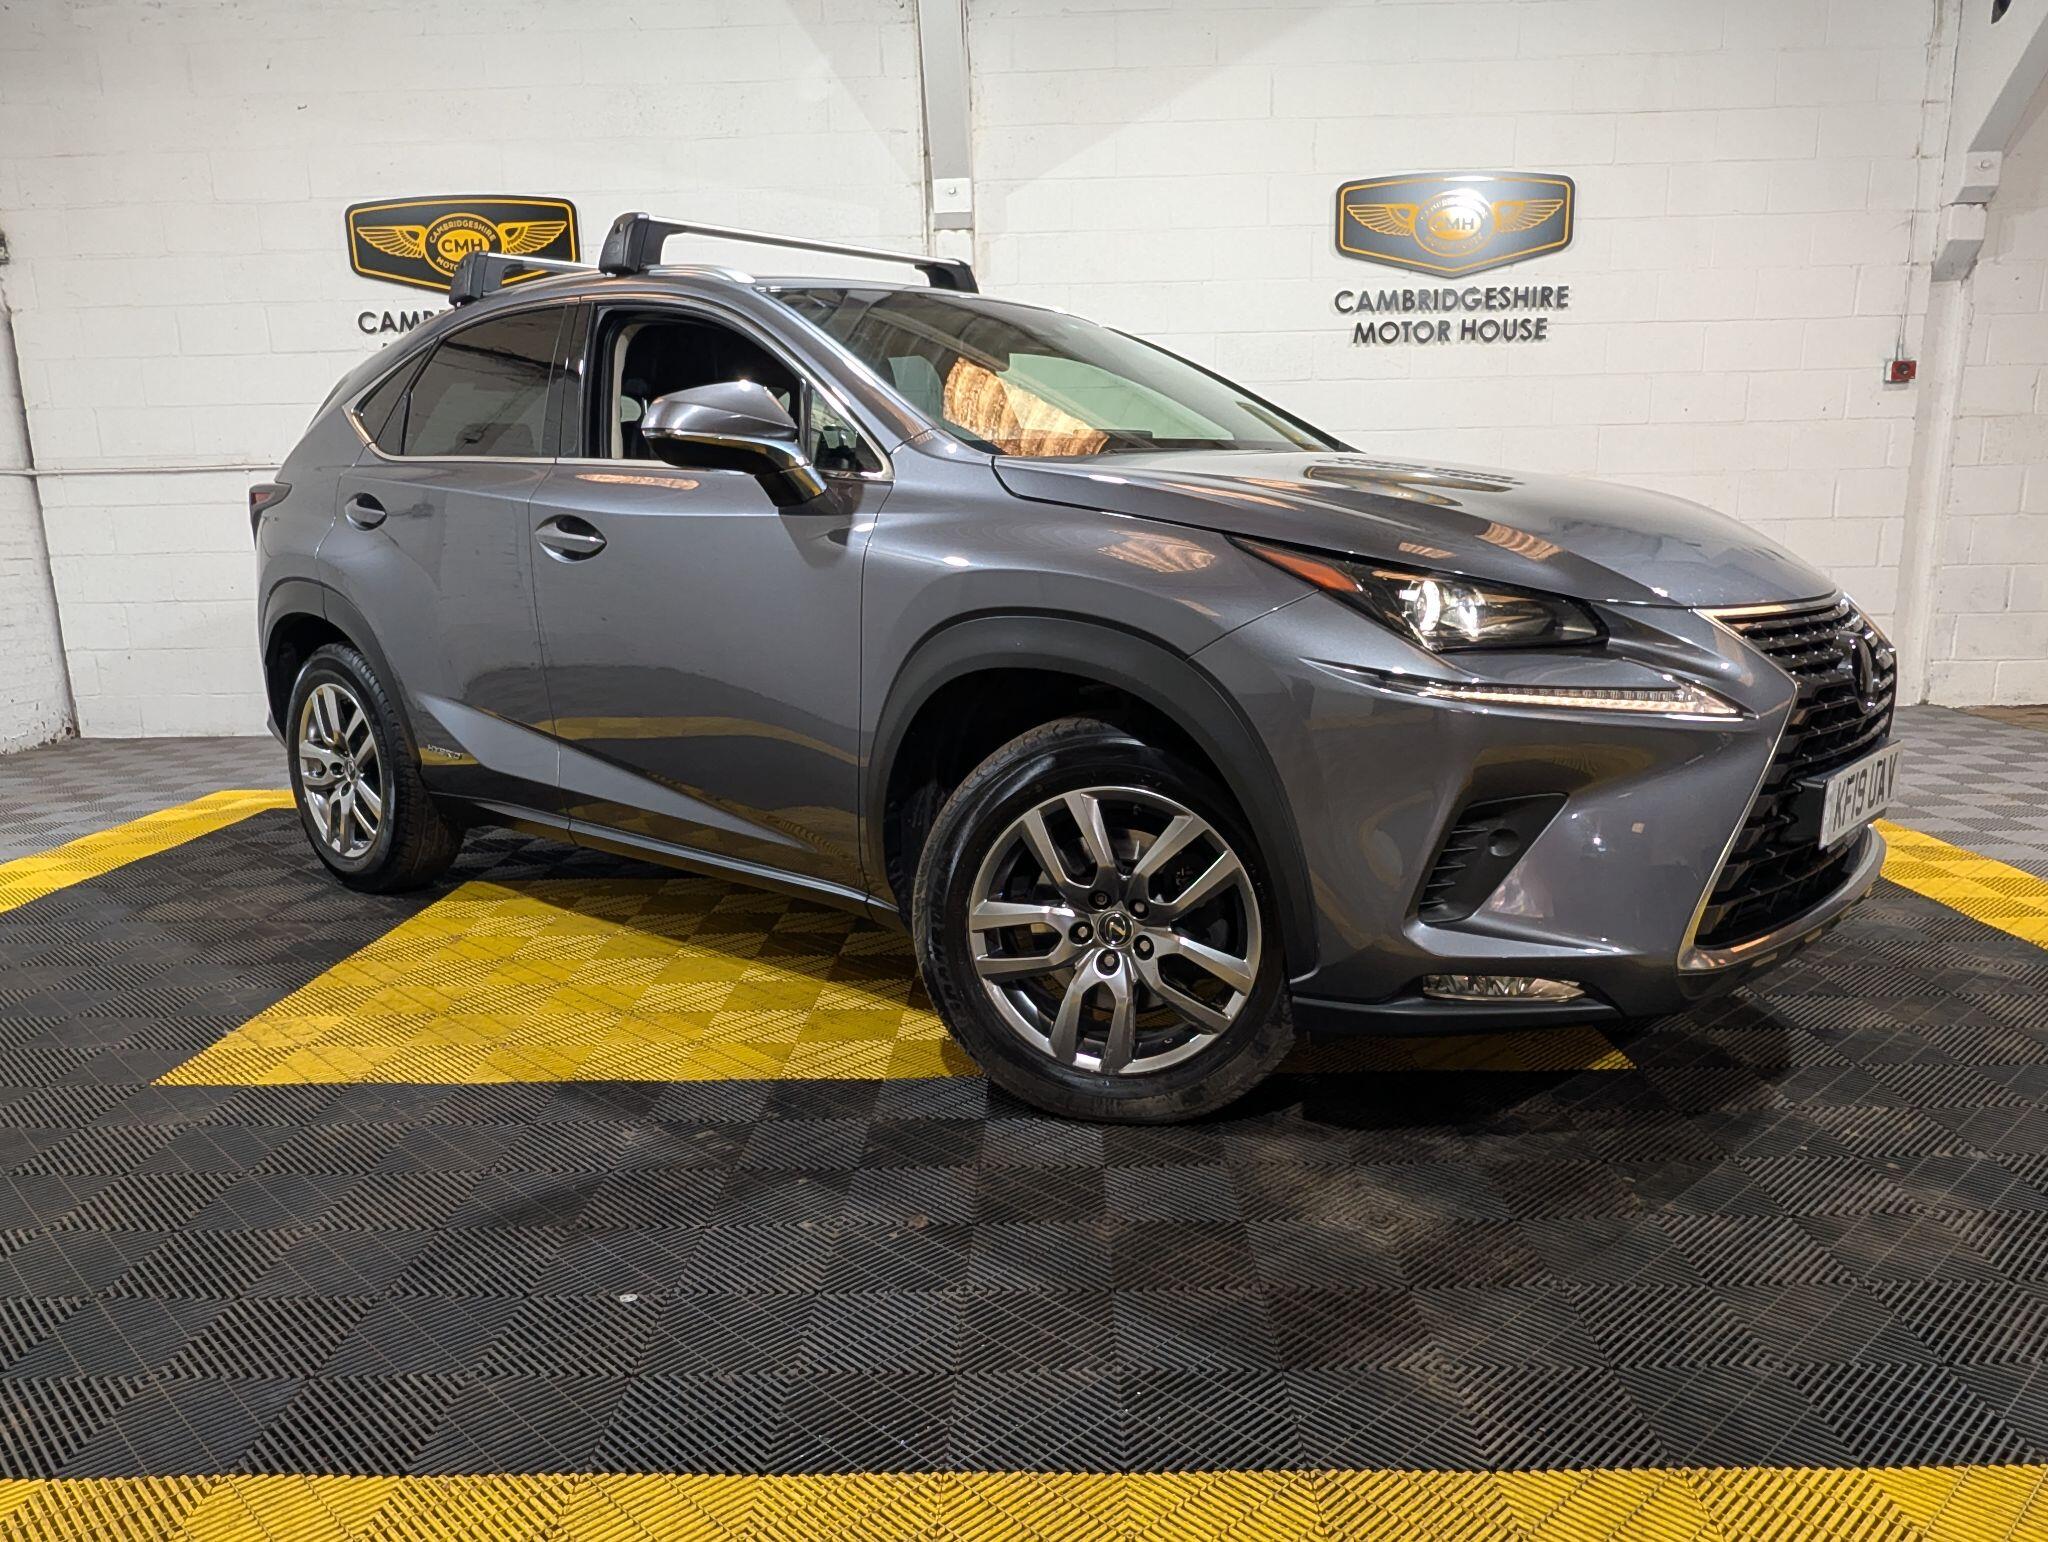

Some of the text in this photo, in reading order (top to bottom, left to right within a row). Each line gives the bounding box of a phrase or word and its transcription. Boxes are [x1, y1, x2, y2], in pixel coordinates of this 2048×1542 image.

[429, 219, 497, 243] CAMBRIDGESHIRE
[441, 238, 483, 253] CMH
[1334, 286, 1570, 313] CAMBRIDGESHIRE
[1353, 318, 1548, 344] MOTOR HOUSE
